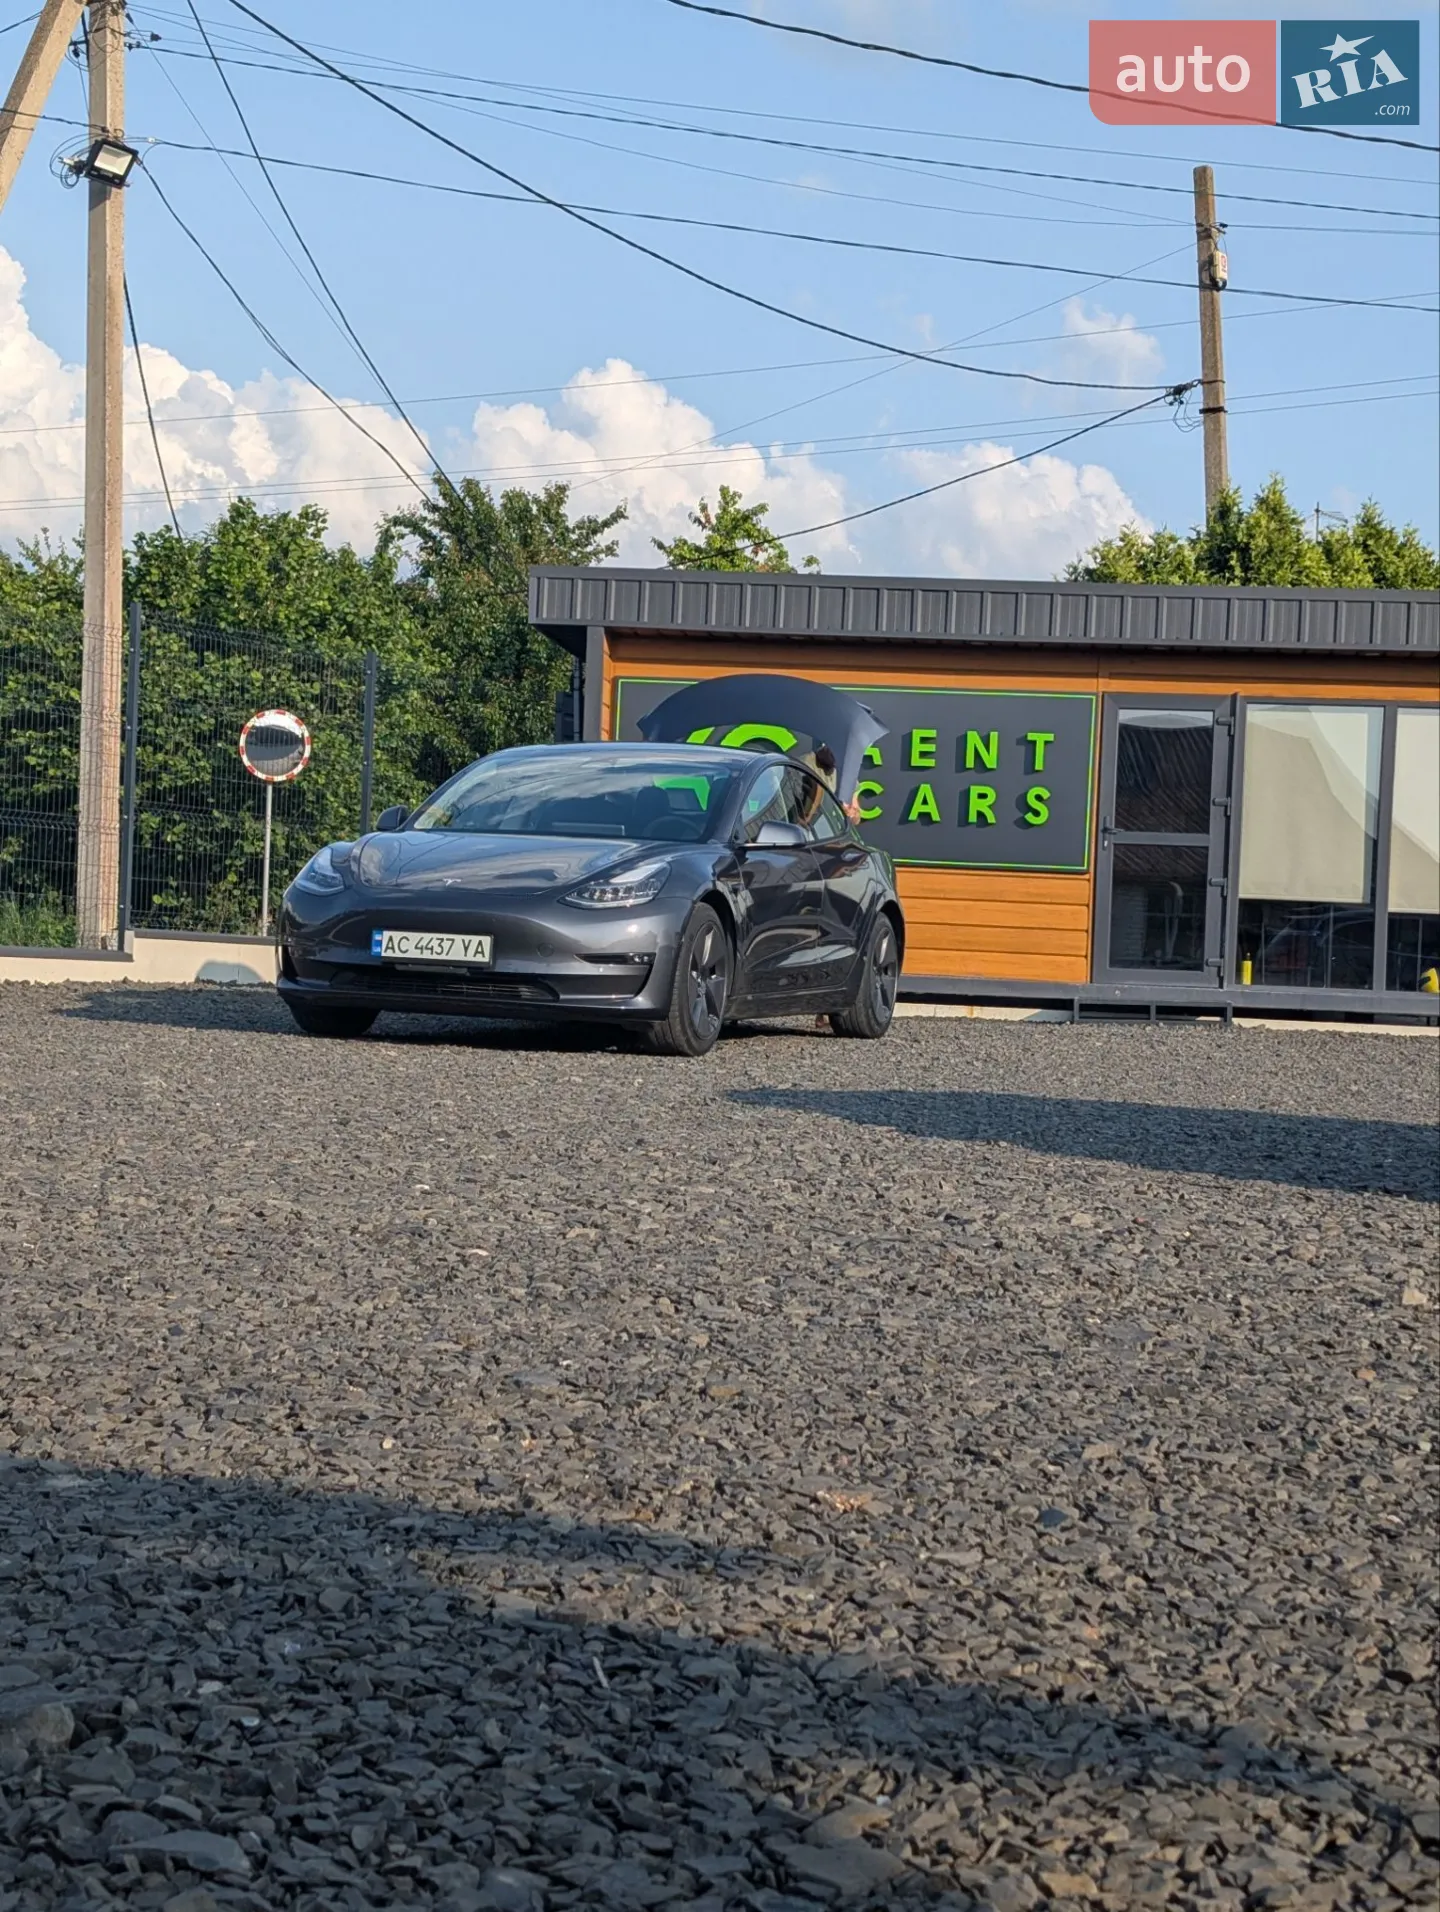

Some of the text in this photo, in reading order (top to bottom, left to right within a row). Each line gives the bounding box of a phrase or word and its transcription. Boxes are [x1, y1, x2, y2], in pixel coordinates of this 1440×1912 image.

[855, 781, 1051, 825] CARS
[384, 935, 486, 958] AC 4437 YA
